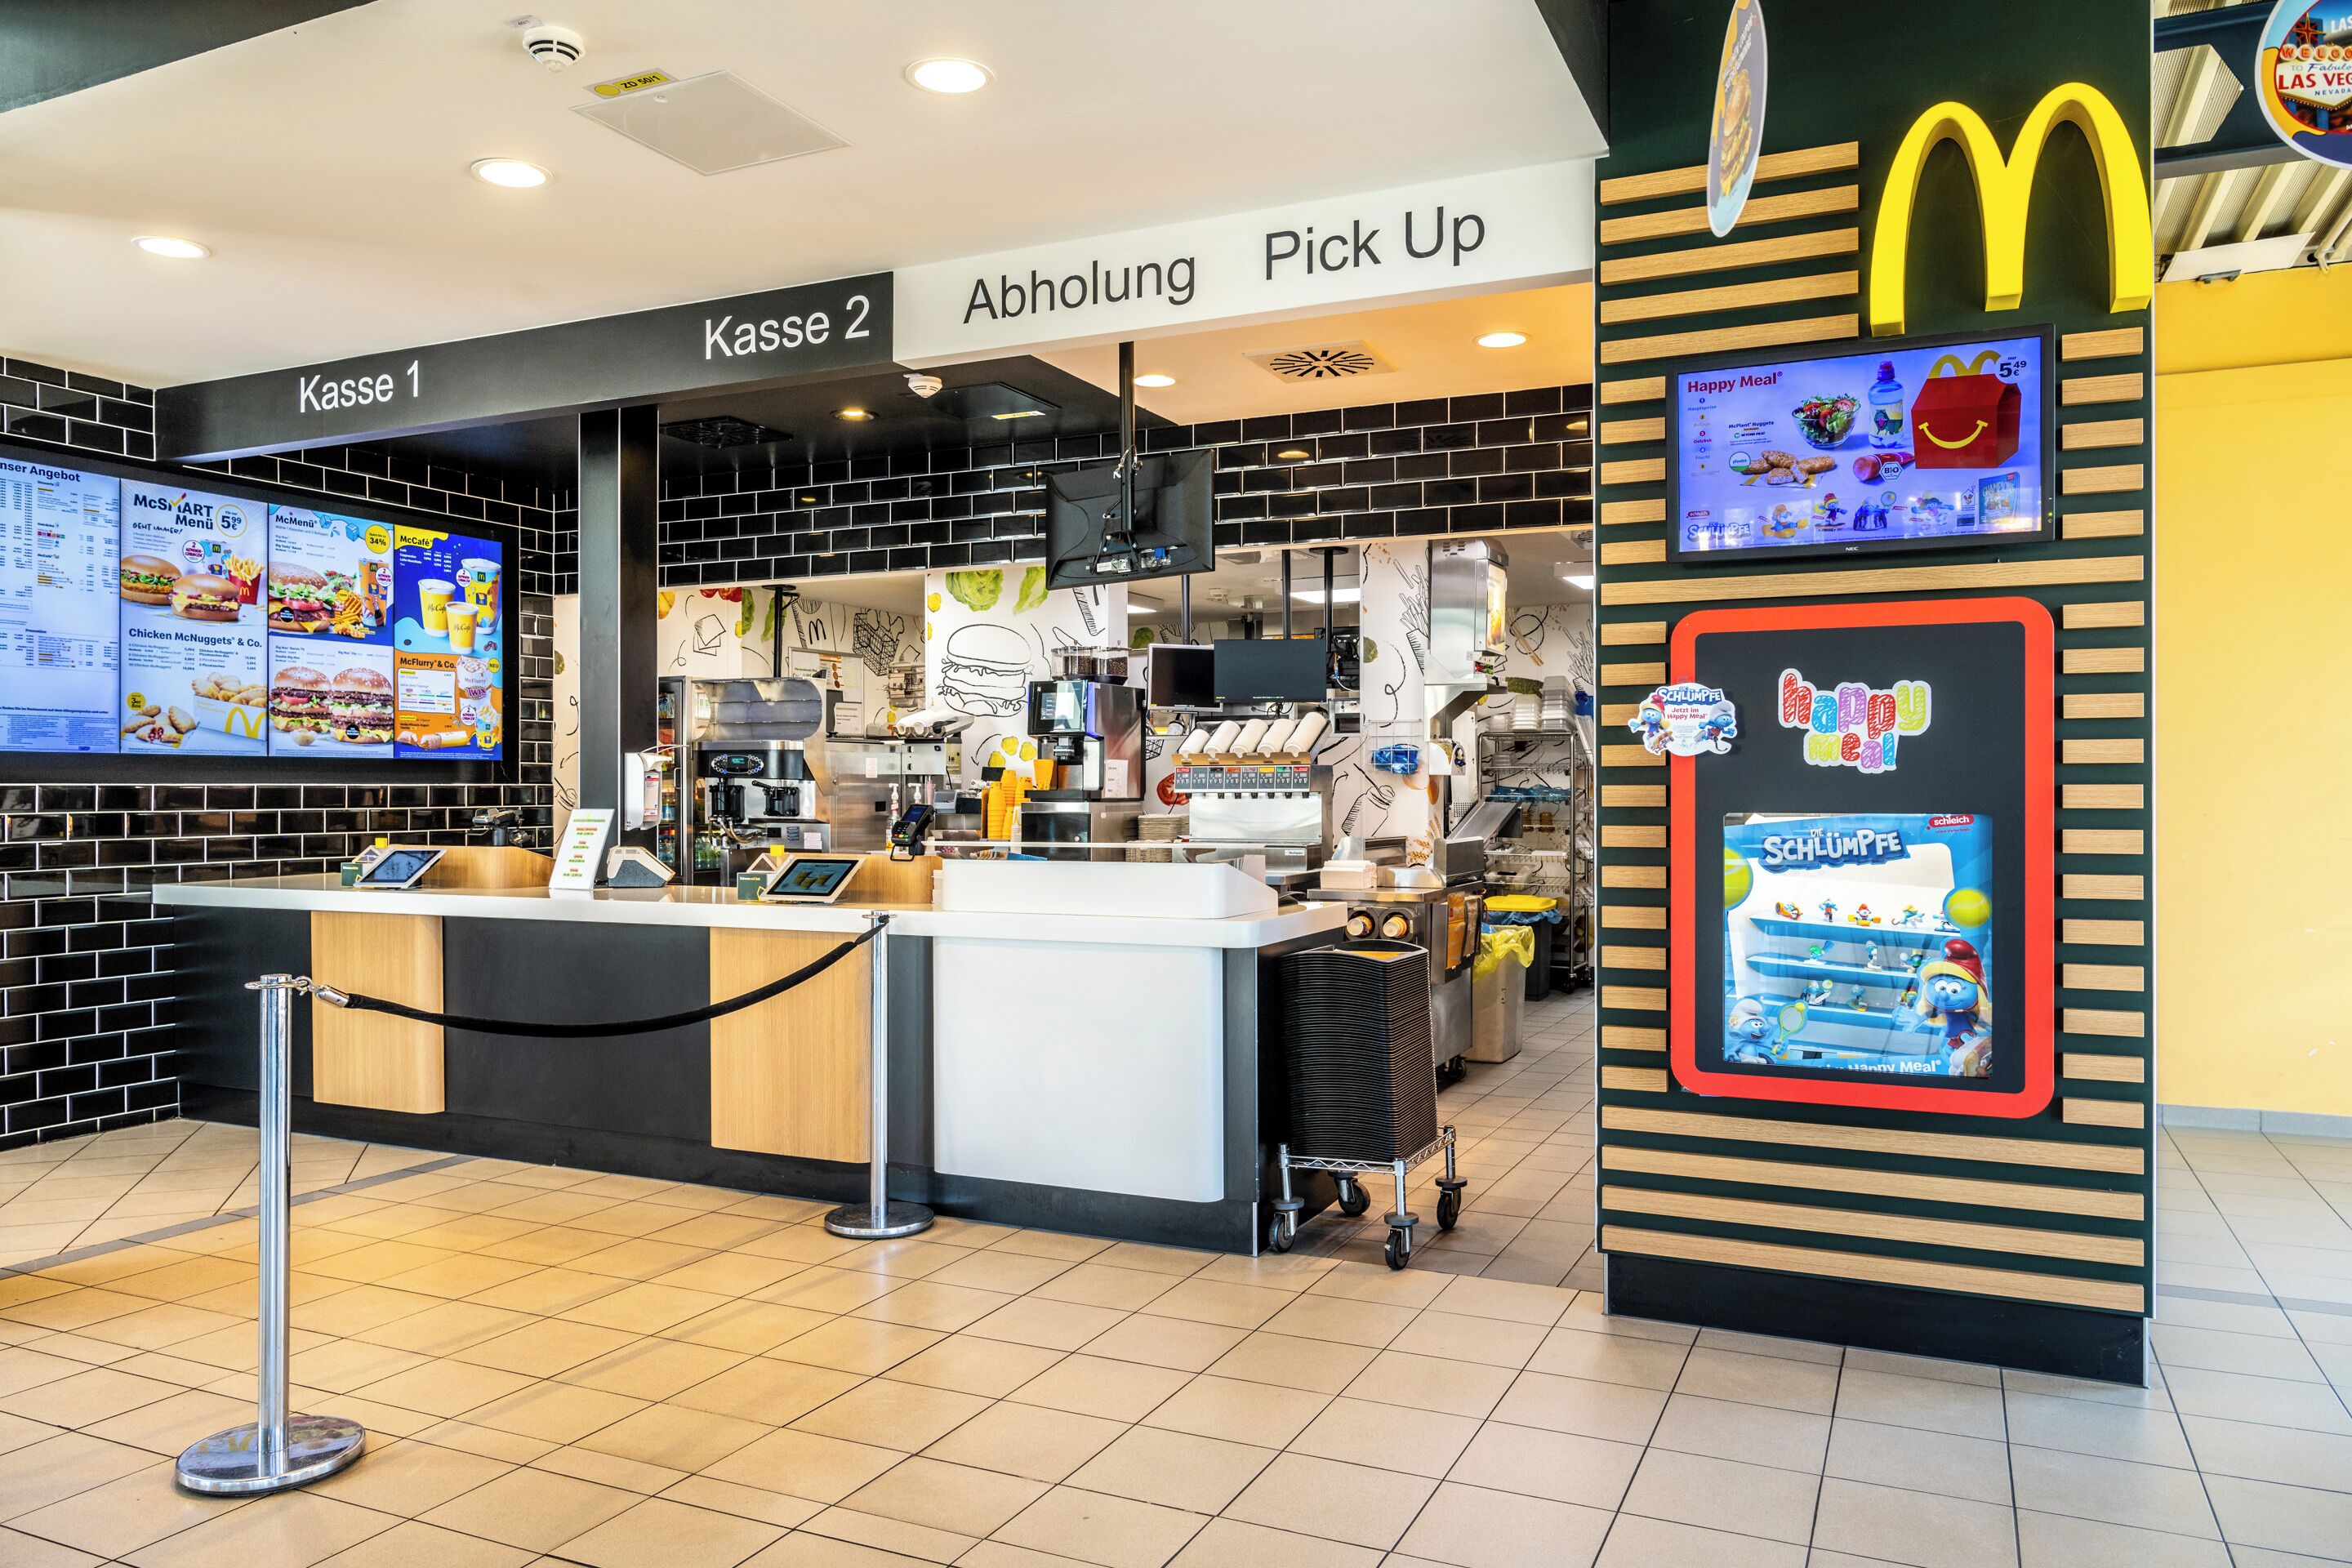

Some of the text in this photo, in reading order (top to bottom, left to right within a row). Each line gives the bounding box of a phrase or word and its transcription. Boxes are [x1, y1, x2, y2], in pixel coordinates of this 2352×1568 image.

[620, 75, 661, 89] ZD 50/1
[2278, 74, 2317, 90] LAS
[2314, 88, 2352, 96] NEVADA
[963, 206, 1486, 325] Abholung Pick Up
[704, 295, 871, 360] Kasse 2
[299, 359, 420, 413] Kasse 1
[1687, 379, 1736, 394] Happy
[0, 462, 81, 482] nser Angebot
[132, 523, 152, 531] GEHT
[175, 514, 214, 530] Menü
[369, 537, 387, 546] 34%
[128, 628, 172, 639] Chicken
[237, 638, 244, 646] &
[247, 639, 262, 648] Co.
[443, 661, 457, 669] Co.
[1658, 688, 1722, 702] SCHLÜMPFE
[1783, 673, 1927, 739] happy
[1808, 732, 1895, 768] meal
[1934, 816, 1970, 826] schleich
[1810, 827, 1824, 837] DIE
[1763, 828, 1903, 866] SCHLÜMPFE
